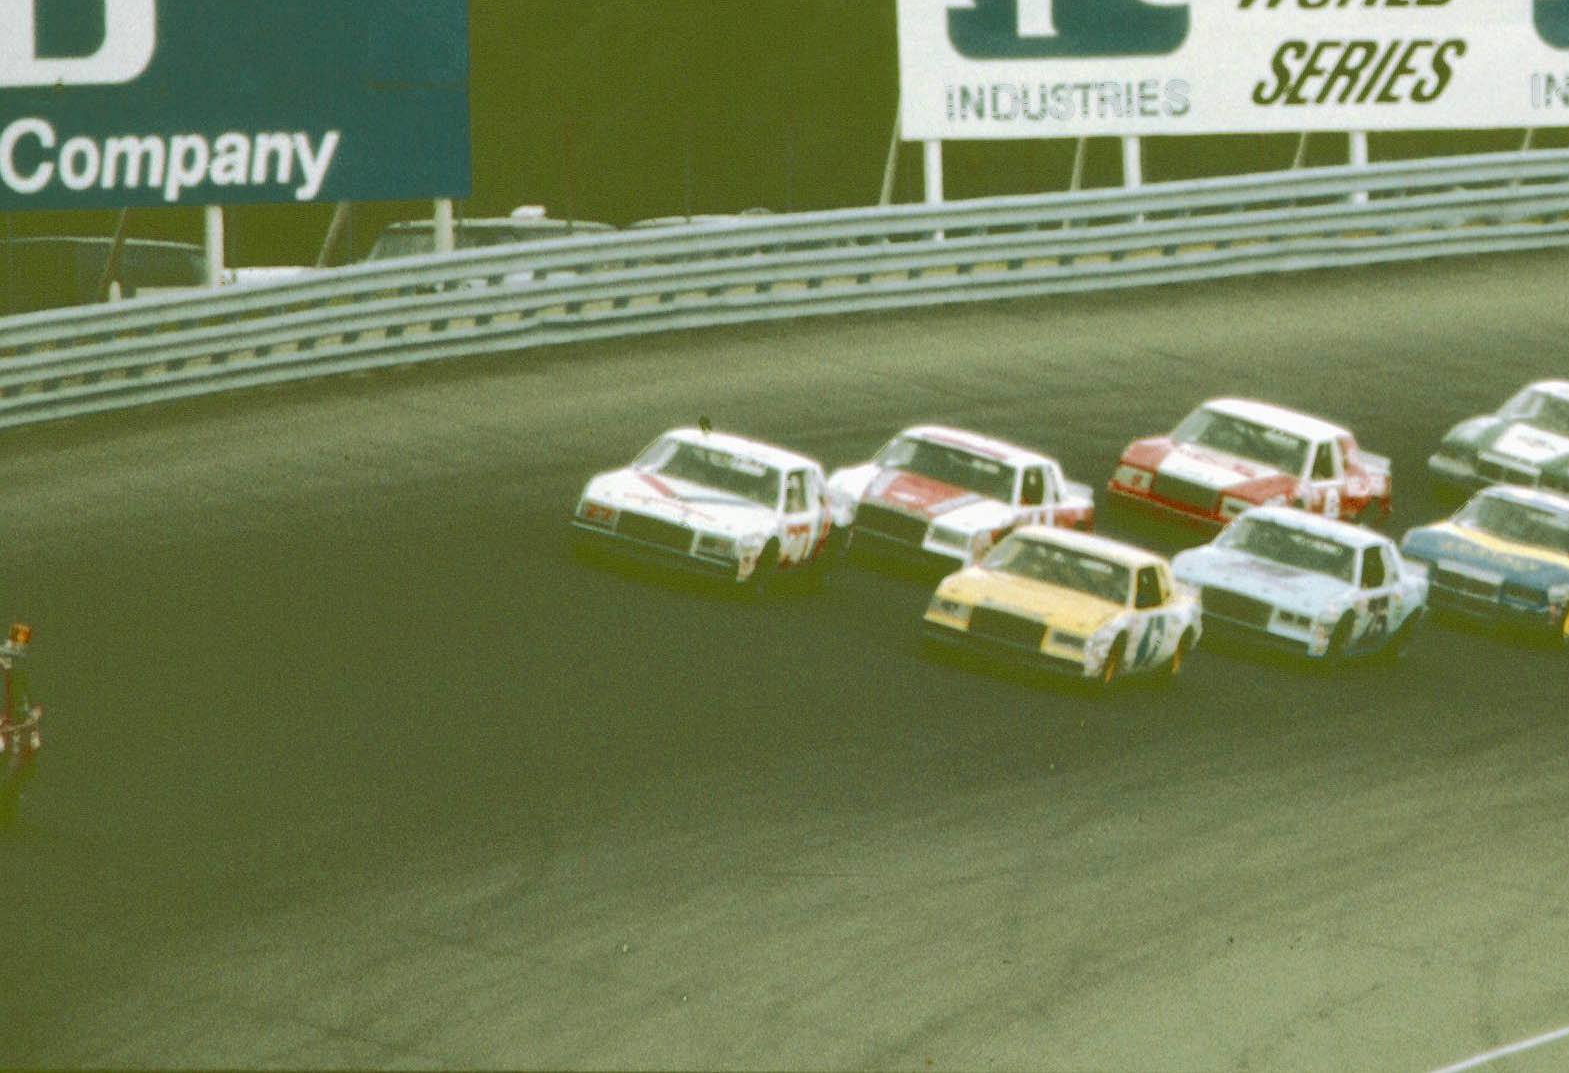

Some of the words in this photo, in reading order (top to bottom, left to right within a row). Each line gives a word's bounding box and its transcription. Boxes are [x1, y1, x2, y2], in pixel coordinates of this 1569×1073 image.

[946, 80, 1191, 121] INDUSTRIES
[1251, 39, 1469, 107] SERIES
[0, 118, 340, 202] Company
